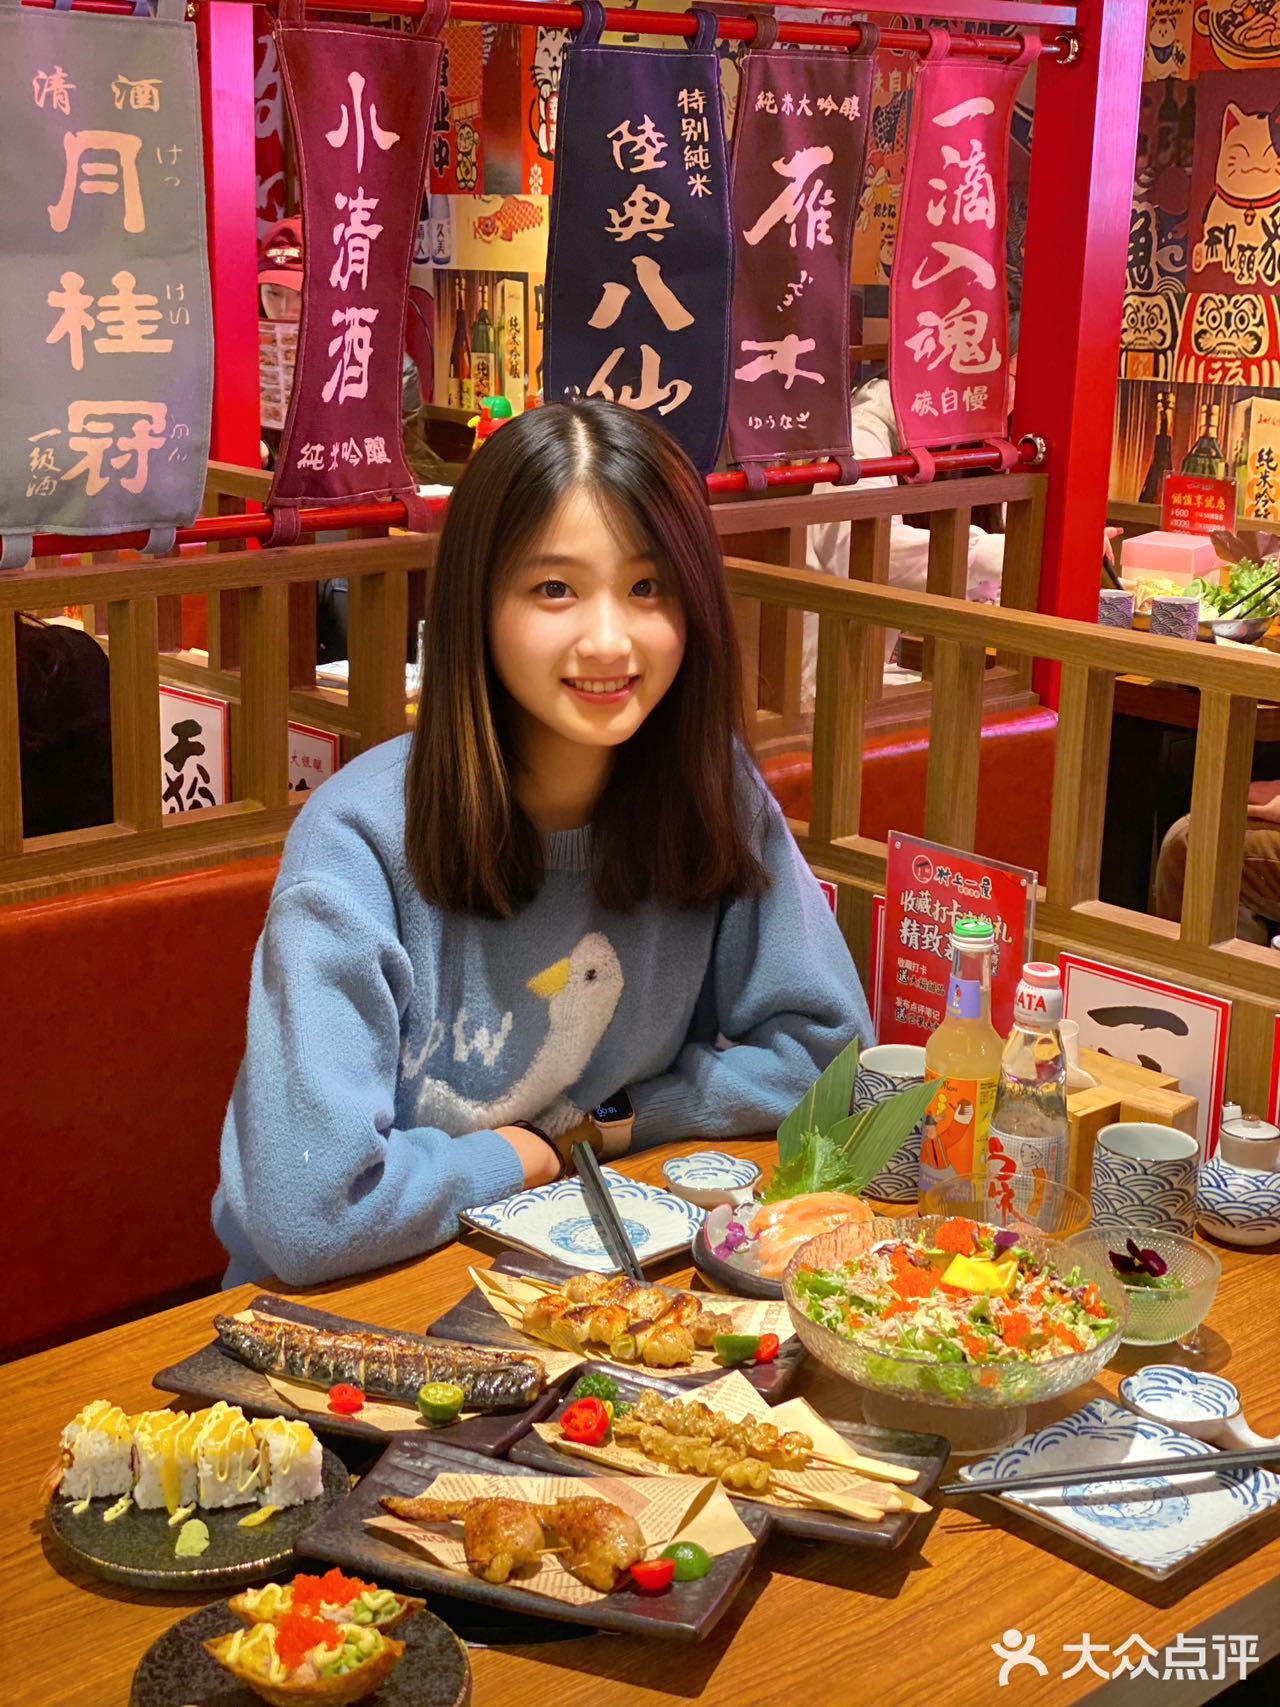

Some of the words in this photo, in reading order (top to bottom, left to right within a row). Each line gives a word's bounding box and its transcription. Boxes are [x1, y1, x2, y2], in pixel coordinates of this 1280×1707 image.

[32, 68, 163, 116] 清酒
[47, 130, 174, 496] 月桂冠
[322, 71, 400, 404] 小清酒
[904, 96, 1001, 375] 一滴入魂
[934, 866, 992, 899] 村上一屋
